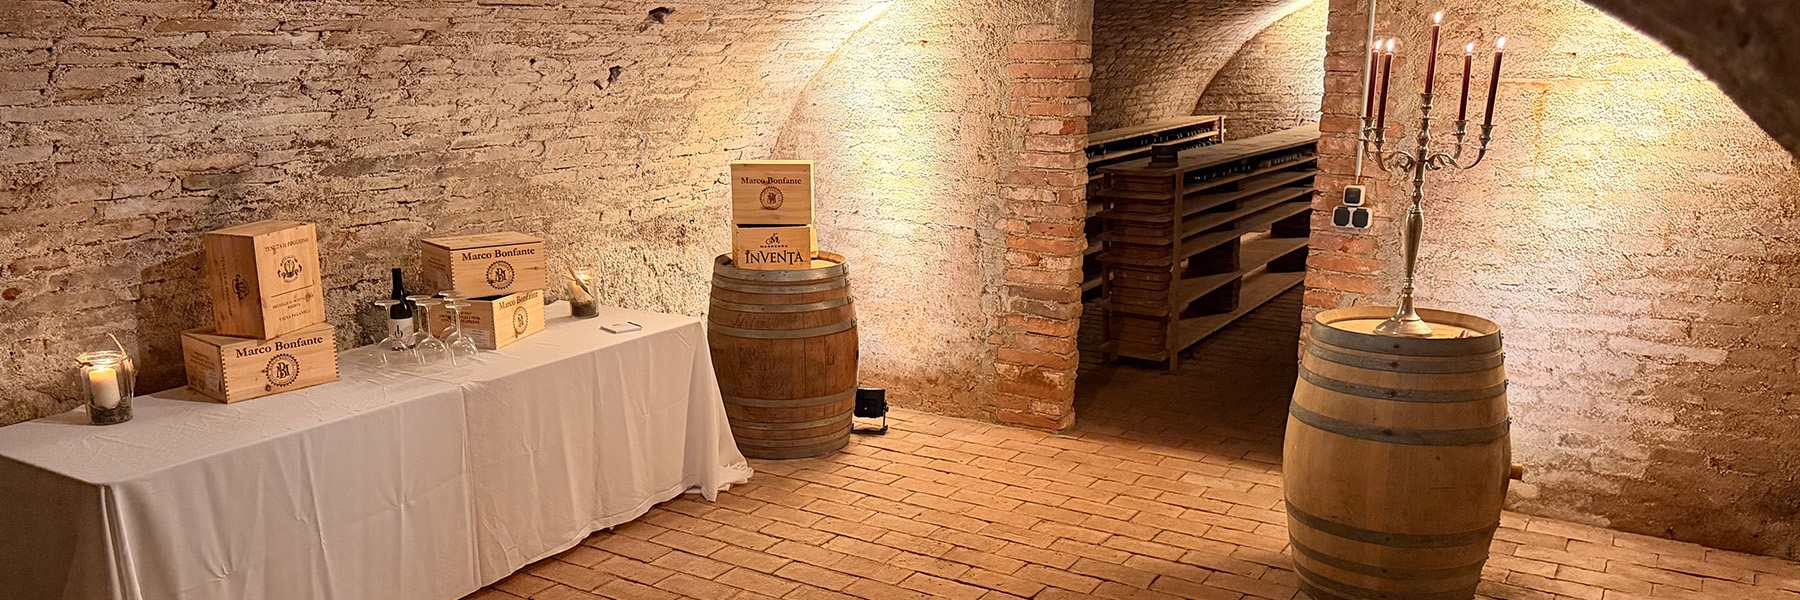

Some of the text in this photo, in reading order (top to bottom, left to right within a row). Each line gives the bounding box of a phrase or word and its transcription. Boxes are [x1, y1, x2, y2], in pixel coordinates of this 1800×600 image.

[741, 177, 802, 185] Marco Bonfante
[462, 247, 536, 261] Marco Bonfante
[745, 250, 804, 265] INVENTA
[498, 292, 538, 310] Marco Bonfante
[235, 335, 324, 359] Marco Bonfante
